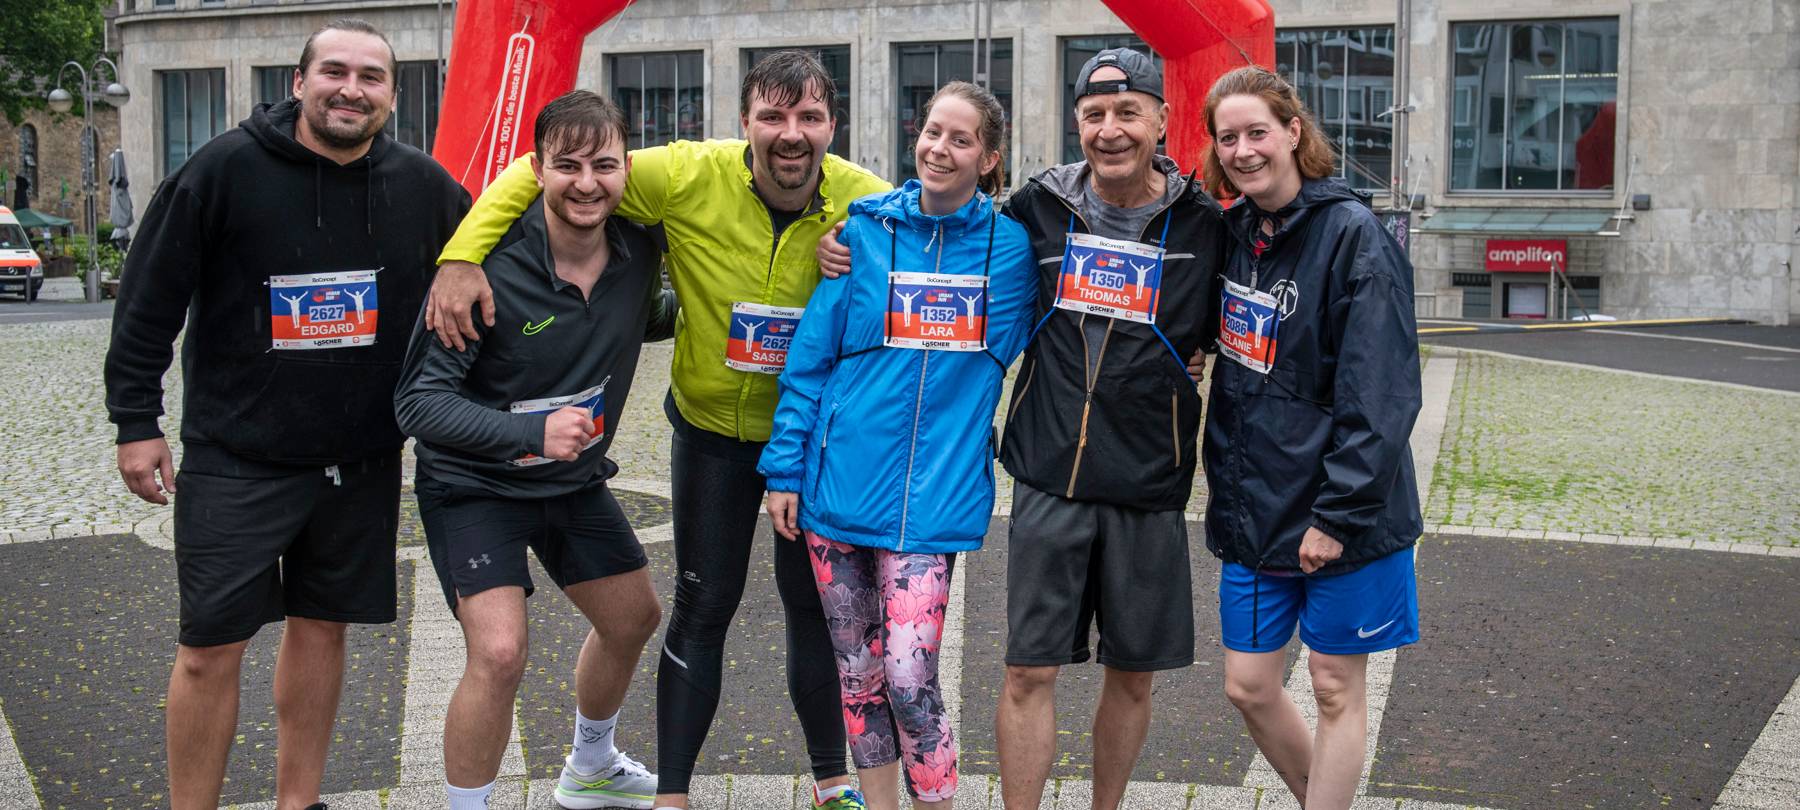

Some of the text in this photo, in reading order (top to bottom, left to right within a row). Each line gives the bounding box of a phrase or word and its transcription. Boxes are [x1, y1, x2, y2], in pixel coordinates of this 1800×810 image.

[512, 44, 526, 75] Musik.
[508, 75, 520, 101] beste
[505, 101, 516, 116] die
[500, 117, 513, 143] 100%
[1488, 246, 1563, 265] amplifon
[1090, 271, 1125, 289] 1350
[1079, 287, 1131, 306] THOMAS
[310, 306, 344, 321] 2627
[921, 308, 956, 322] 1352
[301, 322, 355, 336] EDGARD
[920, 325, 955, 337] LARA
[1225, 314, 1247, 336] 2086
